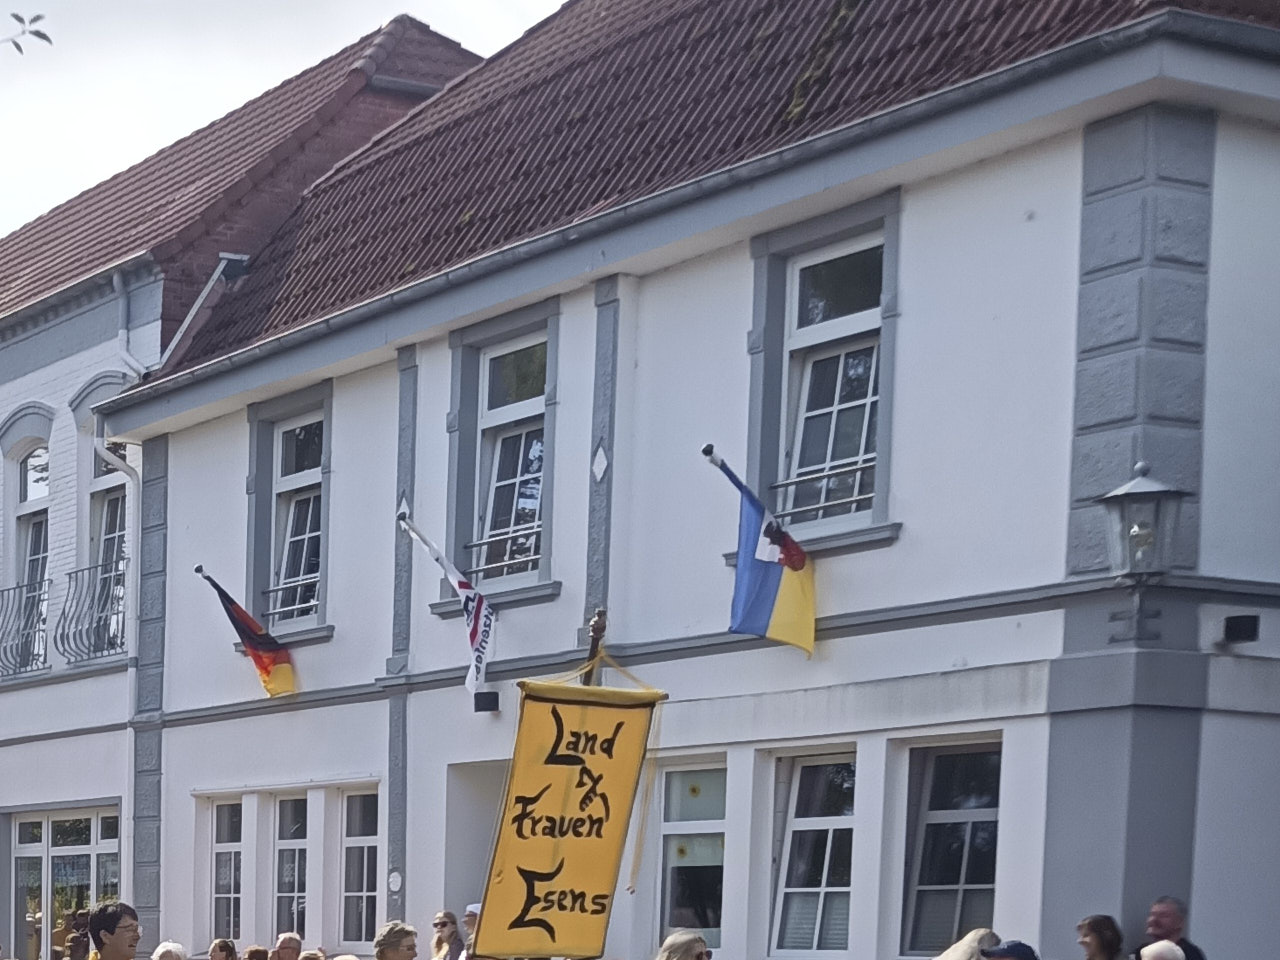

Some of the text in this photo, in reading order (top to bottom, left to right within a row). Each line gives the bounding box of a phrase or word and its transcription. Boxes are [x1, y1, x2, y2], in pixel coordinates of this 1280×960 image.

[544, 704, 626, 765] Land
[511, 783, 605, 840] Frauen
[507, 857, 610, 943] Esens
